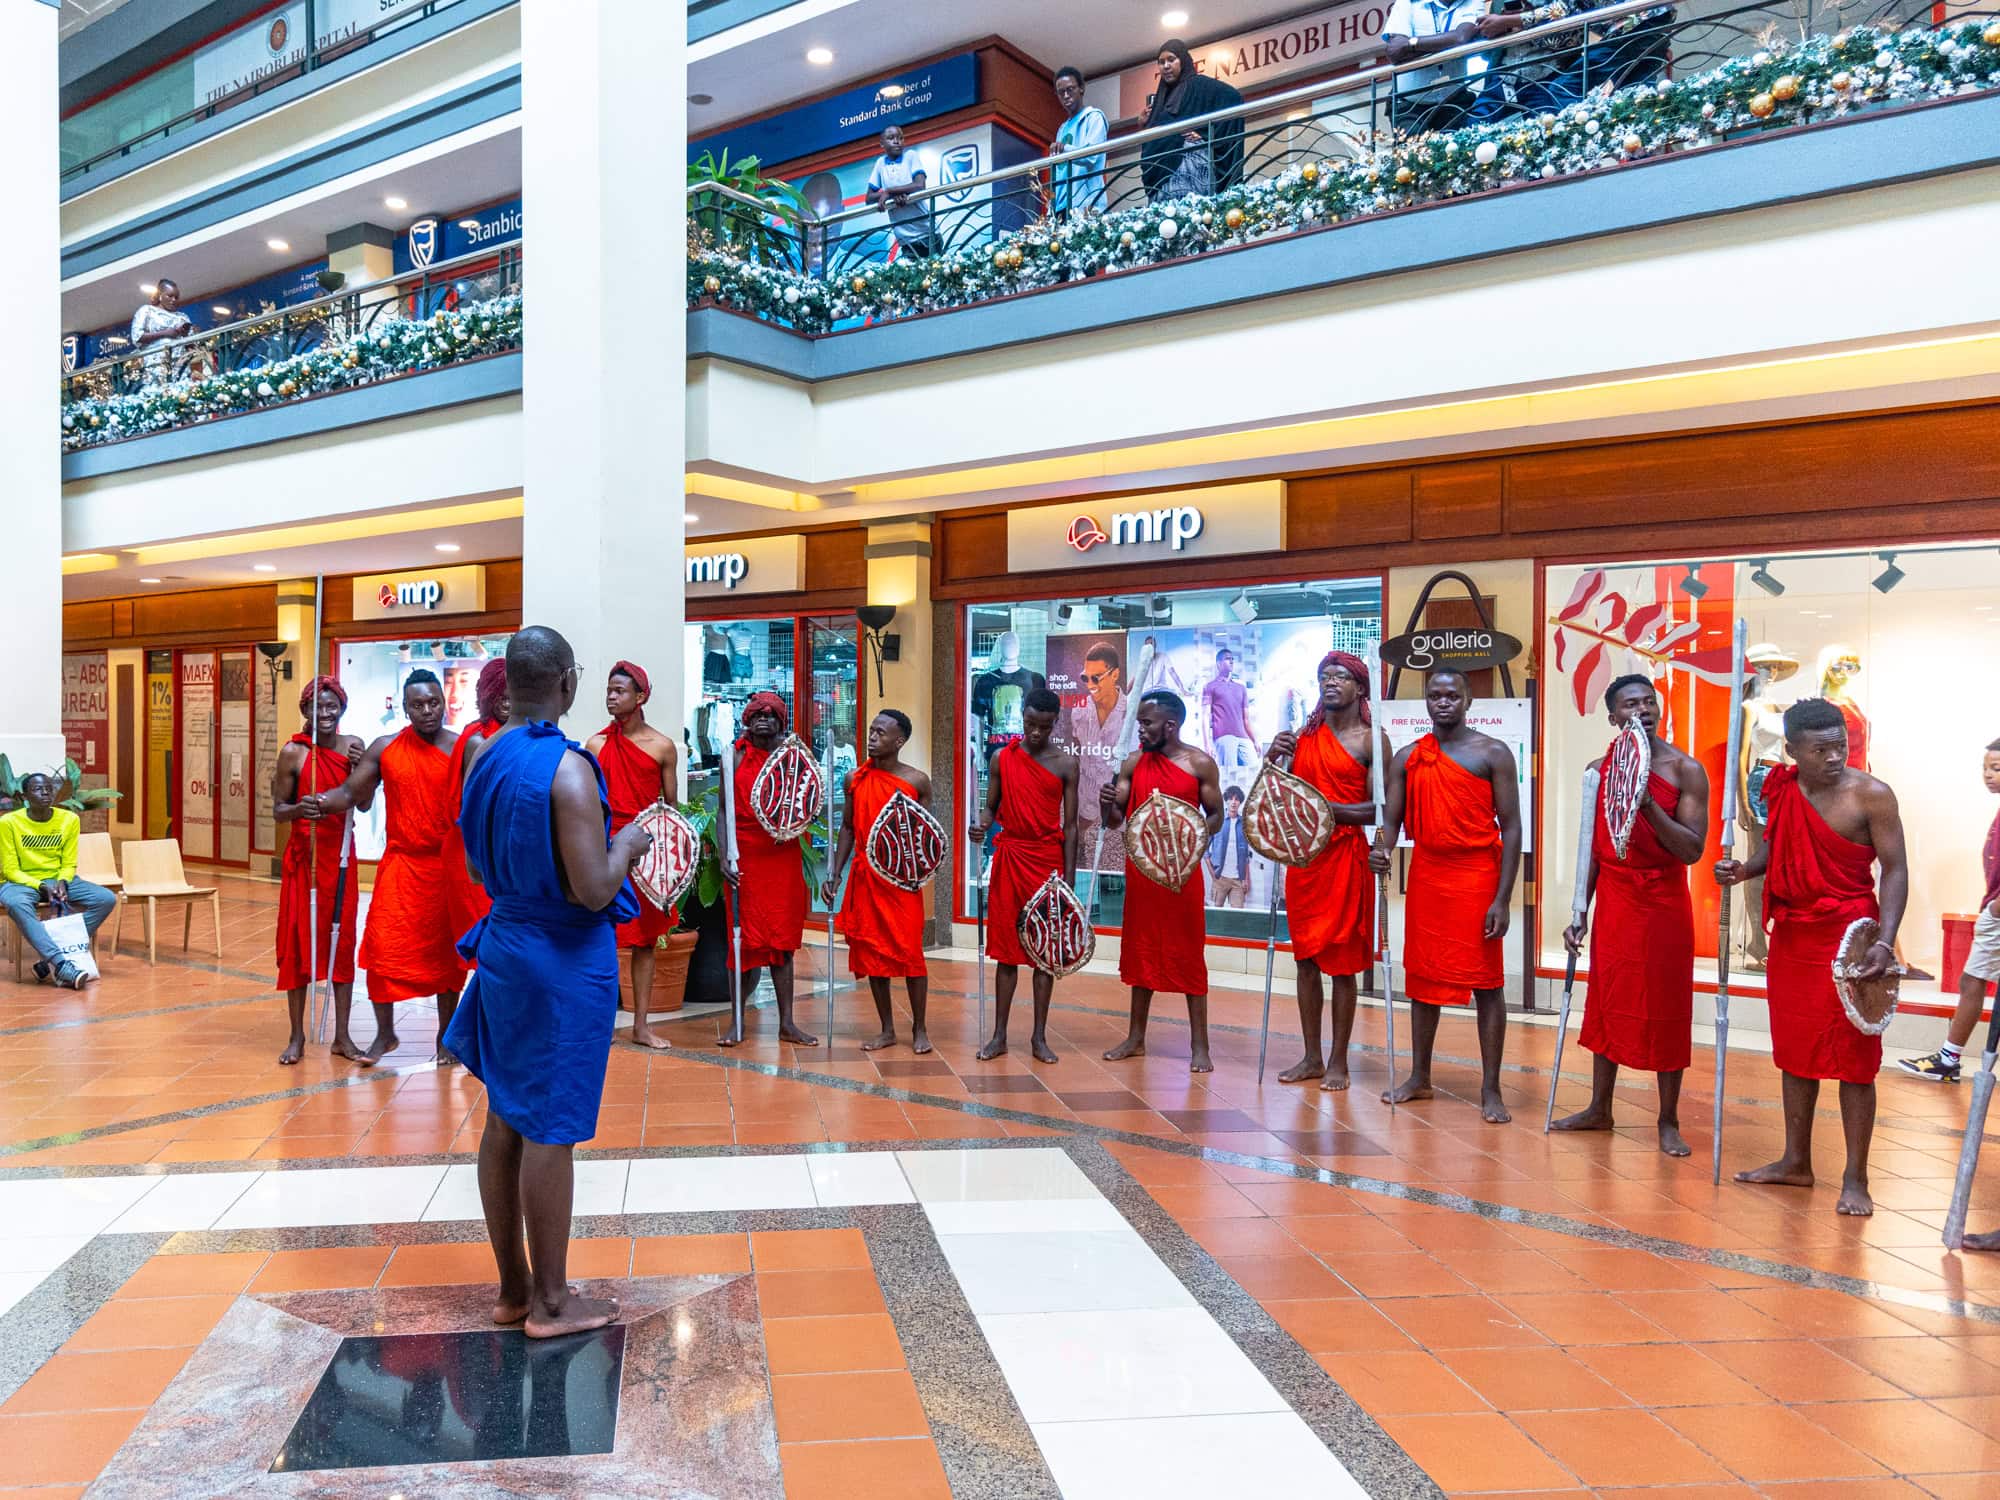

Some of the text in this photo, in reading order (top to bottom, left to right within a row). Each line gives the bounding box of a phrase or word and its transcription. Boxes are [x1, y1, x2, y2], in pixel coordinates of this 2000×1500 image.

[1215, 22, 1330, 80] NAIROBI
[921, 75, 932, 88] of
[839, 91, 932, 128] Standard Bank Group
[467, 209, 522, 245] Stanbic
[1111, 506, 1203, 551] mrp
[686, 553, 748, 589] mrp
[397, 580, 442, 610] mrp
[1406, 630, 1492, 669] galleria
[80, 663, 107, 685] ABC
[183, 663, 214, 682] MAFX
[1049, 673, 1069, 683] shop
[152, 681, 172, 705] 1%
[1049, 681, 1077, 690] the edit
[1391, 718, 1409, 726] FIRE
[1480, 717, 1503, 725] PLAN
[191, 780, 207, 796] 0%
[229, 782, 245, 798] 0%
